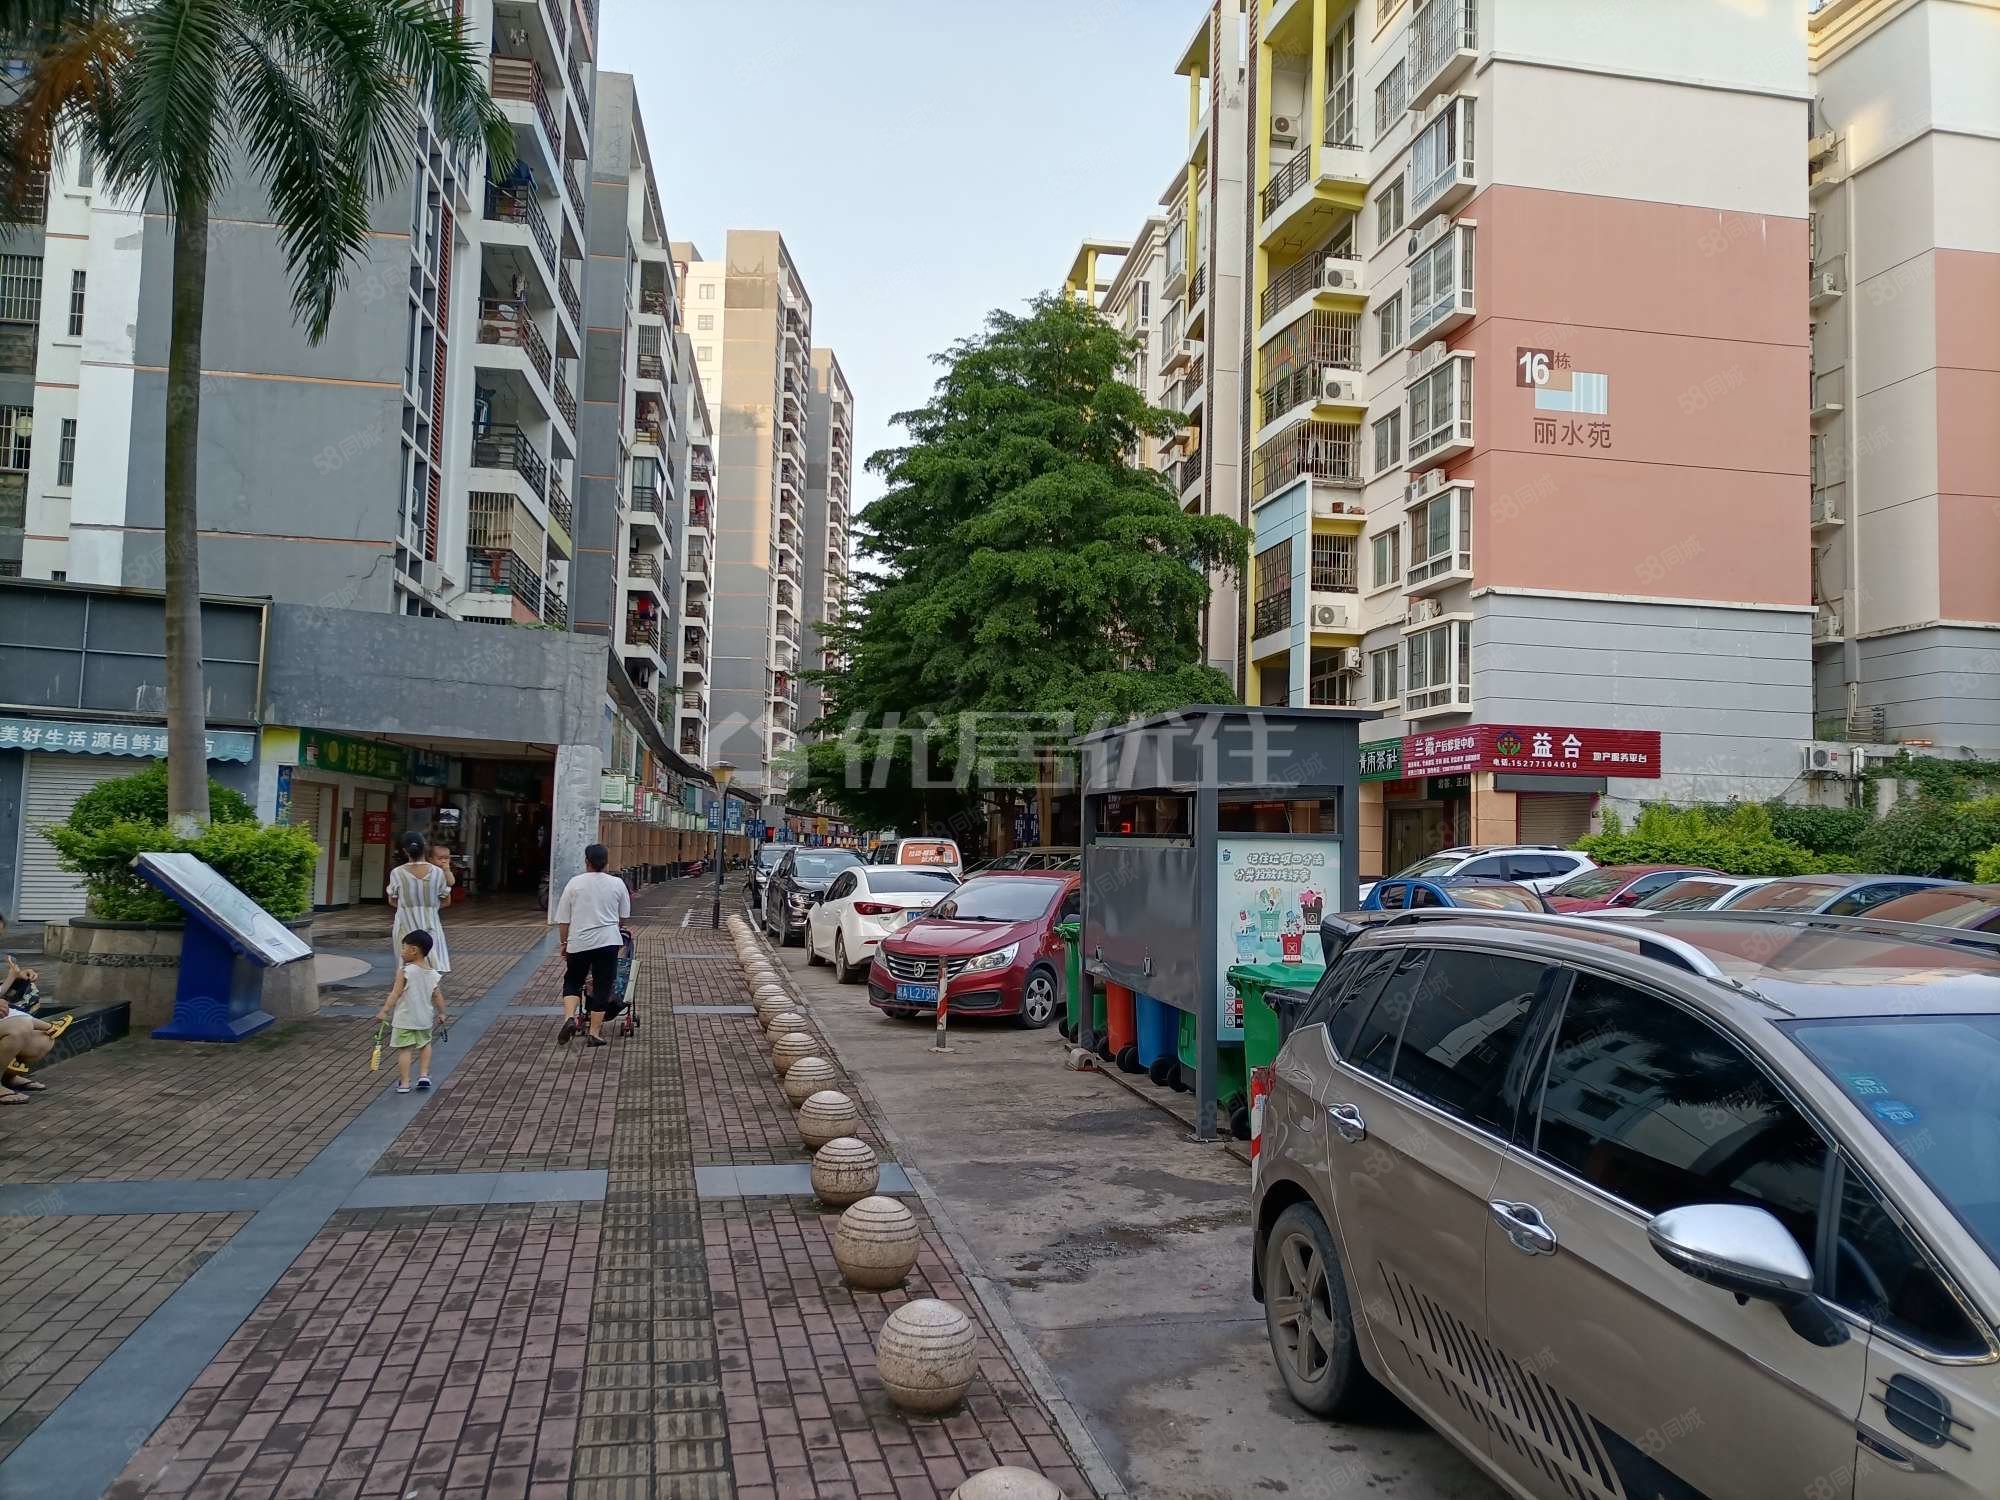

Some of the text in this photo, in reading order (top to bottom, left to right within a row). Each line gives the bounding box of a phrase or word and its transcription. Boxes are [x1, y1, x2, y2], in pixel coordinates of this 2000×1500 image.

[1533, 416, 1613, 449] 丽水苑
[0, 725, 86, 748] 美好生活
[1531, 732, 1583, 759] 益合
[1592, 752, 1648, 763] 地产服务平台
[1247, 852, 1325, 866] 记住垃圾四分法
